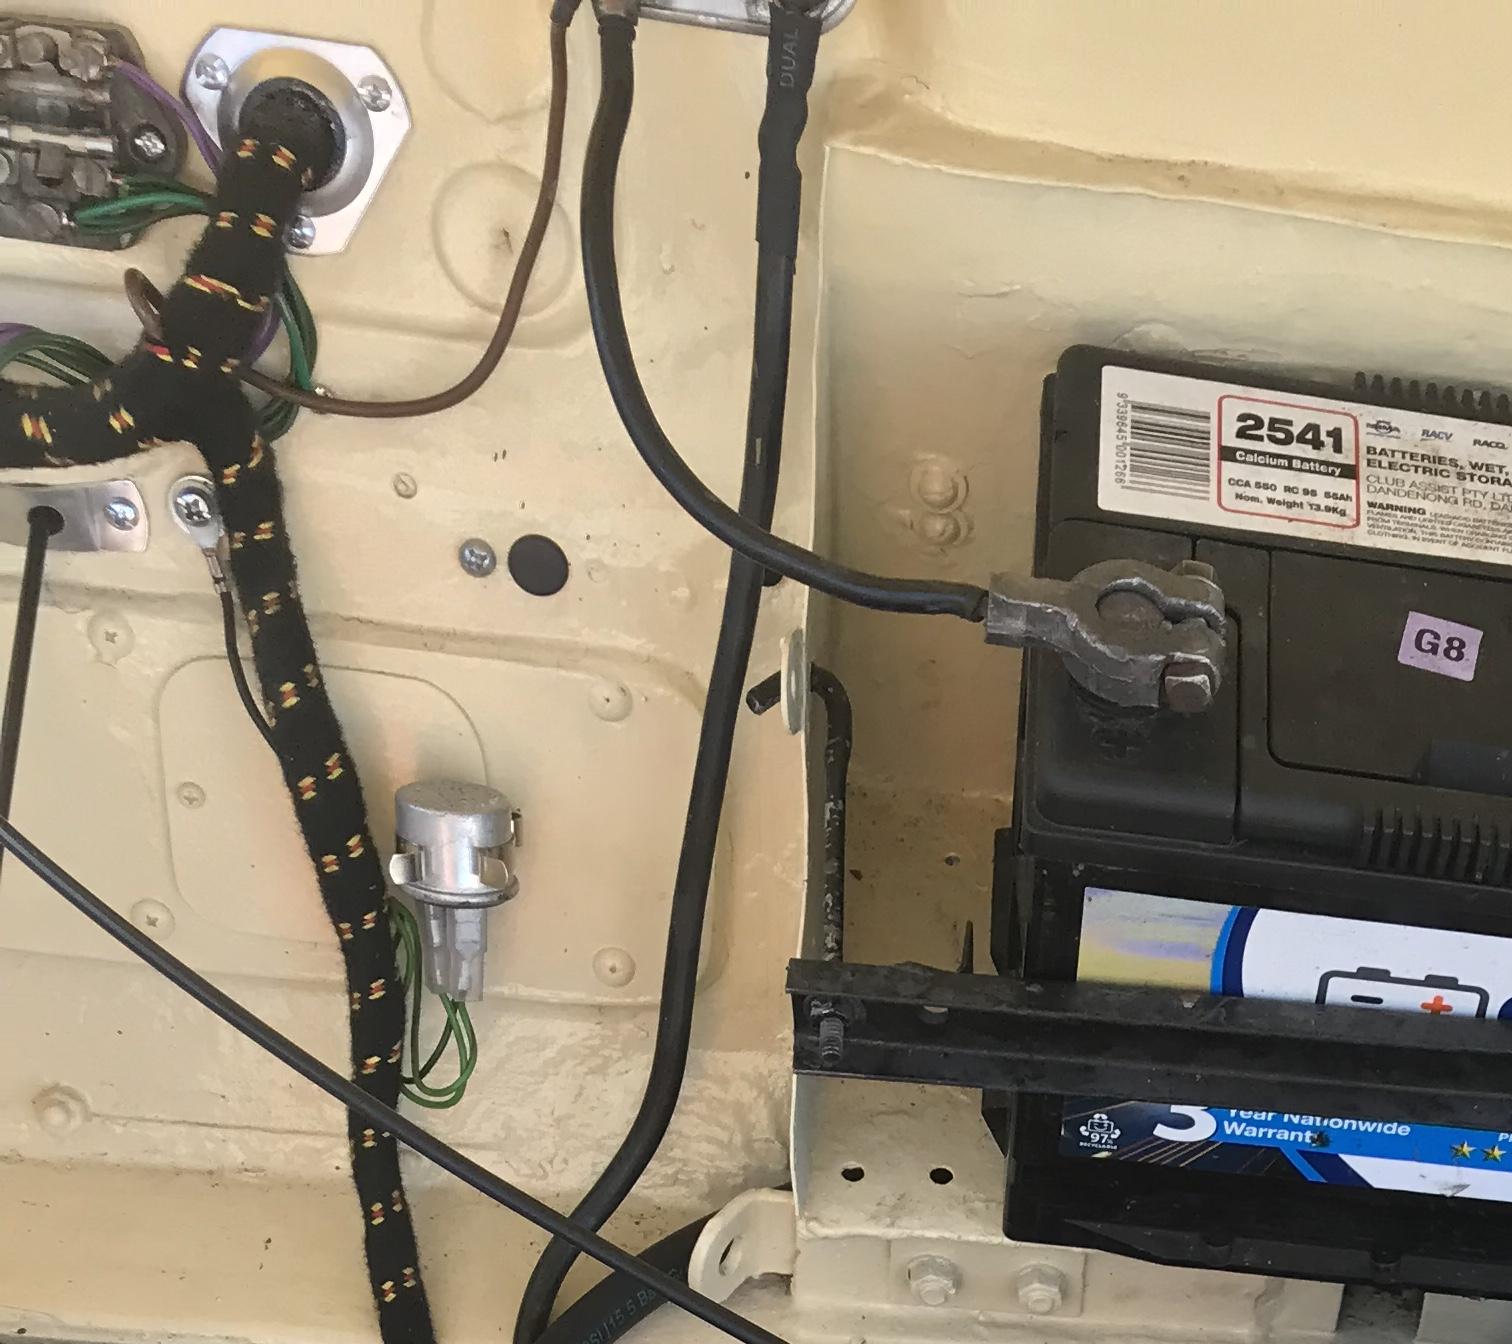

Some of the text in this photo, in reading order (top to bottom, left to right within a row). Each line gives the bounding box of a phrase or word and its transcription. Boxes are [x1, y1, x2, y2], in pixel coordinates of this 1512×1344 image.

[1235, 412, 1344, 454] 2541
[1421, 429, 1454, 441] RACV
[1235, 450, 1342, 477] Calcium Battery
[1366, 458, 1450, 479] ELECTRIC
[1227, 477, 1252, 489] CCA
[1283, 484, 1300, 495] RC
[1366, 474, 1406, 488] CLUB
[1409, 480, 1457, 495] ASSIST
[1462, 487, 1489, 499] PTY
[1366, 484, 1459, 505] DANDENONG
[1266, 496, 1305, 512] Weight
[1366, 500, 1427, 516] WARNING
[1414, 628, 1467, 663] G8
[1223, 1120, 1328, 1147] Warrant
[1282, 1112, 1412, 1136] Nationwide
